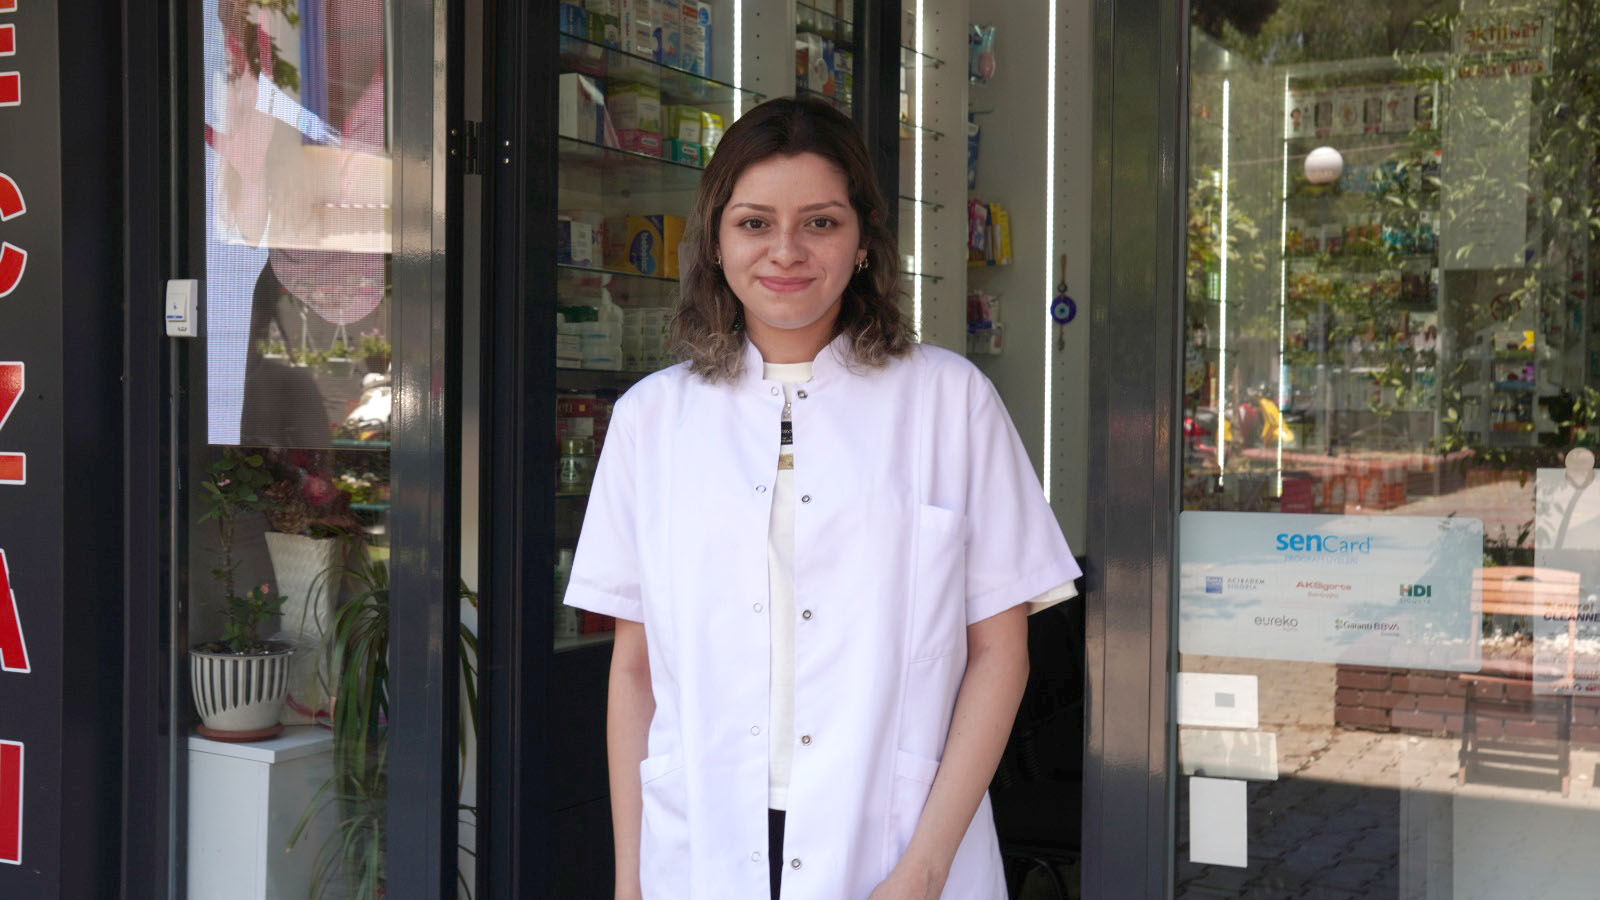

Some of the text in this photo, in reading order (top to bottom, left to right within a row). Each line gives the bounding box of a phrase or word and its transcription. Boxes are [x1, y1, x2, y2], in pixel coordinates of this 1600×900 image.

[1275, 533, 1371, 554] senCard
[1399, 583, 1432, 598] HDI
[1253, 615, 1299, 628] eureko
